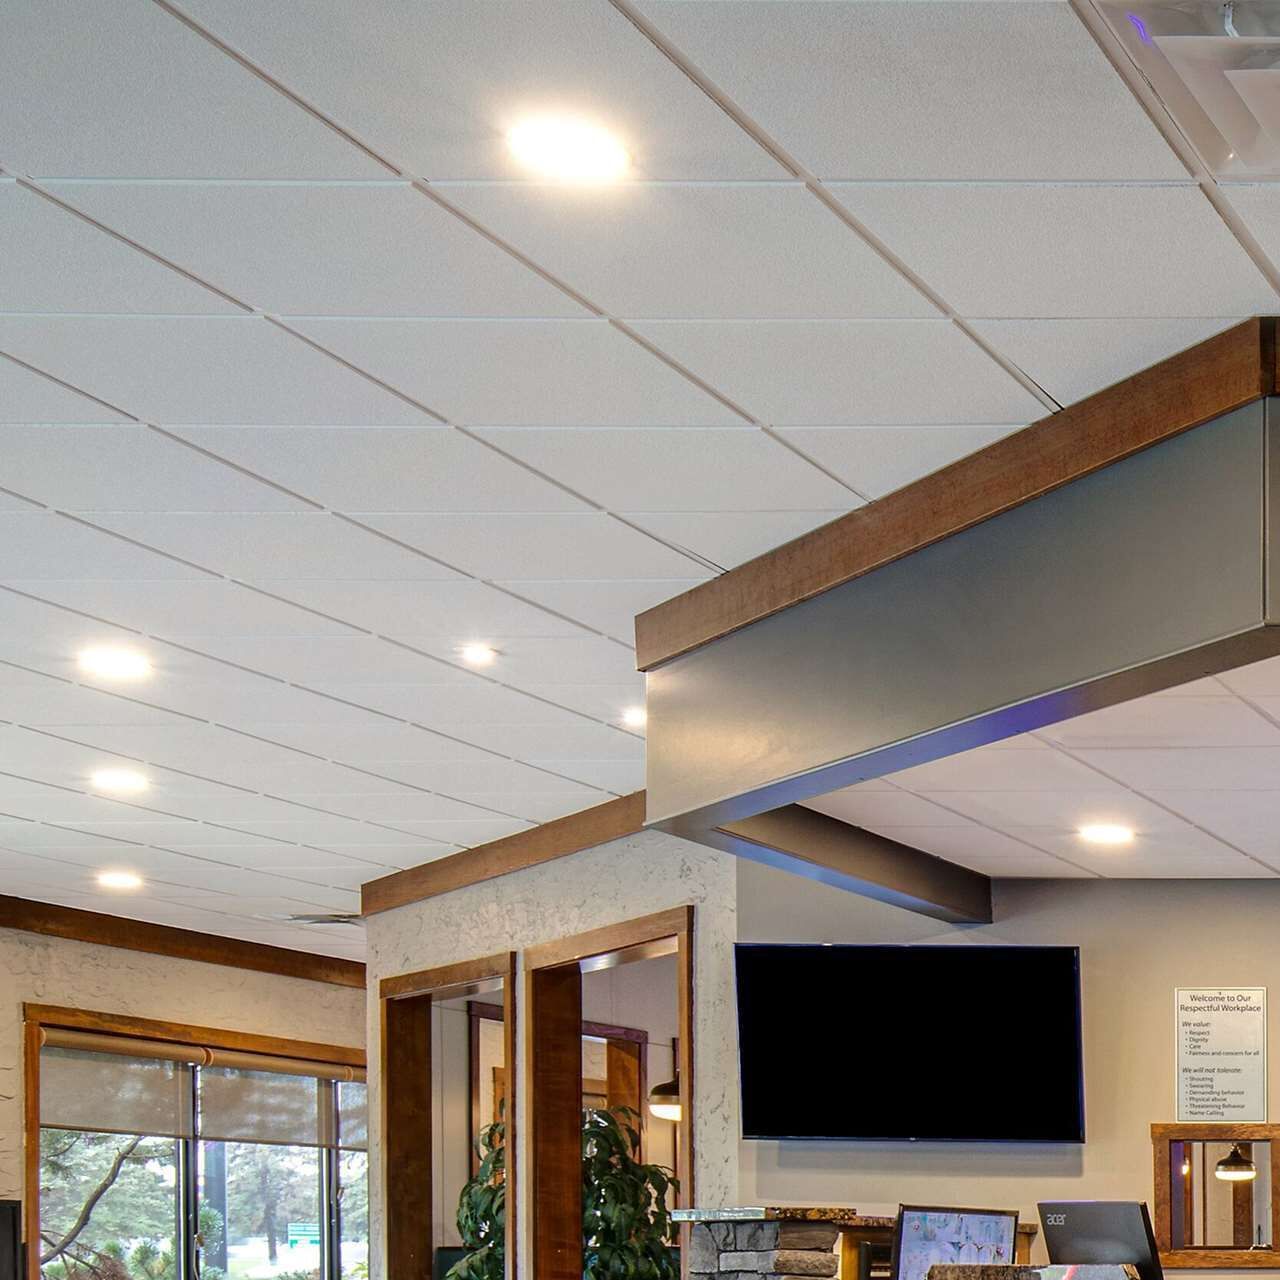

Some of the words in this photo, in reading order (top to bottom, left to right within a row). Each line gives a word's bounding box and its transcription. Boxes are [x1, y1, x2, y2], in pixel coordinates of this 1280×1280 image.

[1180, 1005, 1220, 1013] Respectful
[1221, 1005, 1261, 1013] Workplace
[1046, 1214, 1066, 1225] acer
